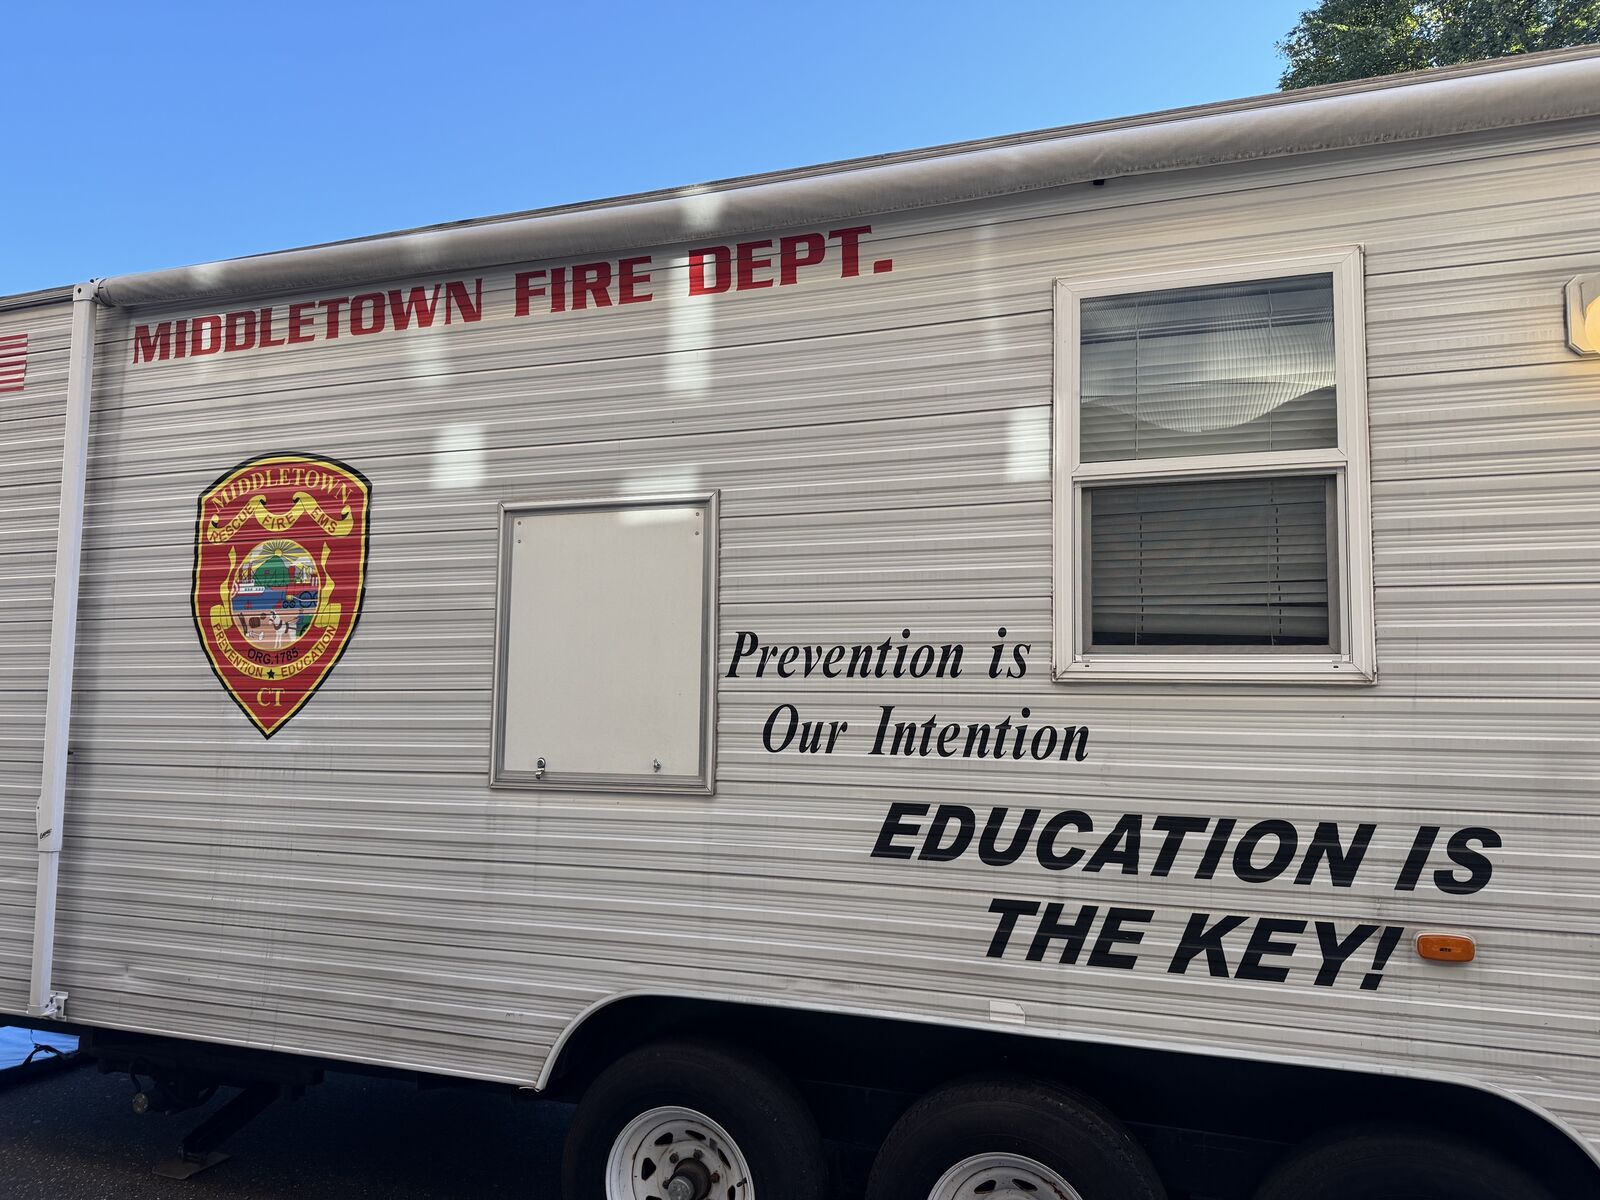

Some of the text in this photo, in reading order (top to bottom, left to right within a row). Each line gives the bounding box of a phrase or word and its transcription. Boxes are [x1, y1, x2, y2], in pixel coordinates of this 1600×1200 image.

[132, 225, 894, 364] MIDDLETOWN FIRE DEPT.
[212, 468, 353, 513] MIDDLETOWN
[209, 504, 338, 542] RESCUE FIRE EMS
[213, 623, 337, 678] PREVENTION EDUCATION
[725, 627, 1031, 679] Prevention is
[256, 687, 286, 707] CT
[762, 703, 1090, 762] Our Intention
[870, 802, 1502, 895] EDUCATION IS
[986, 898, 1405, 992] THE KEY!
